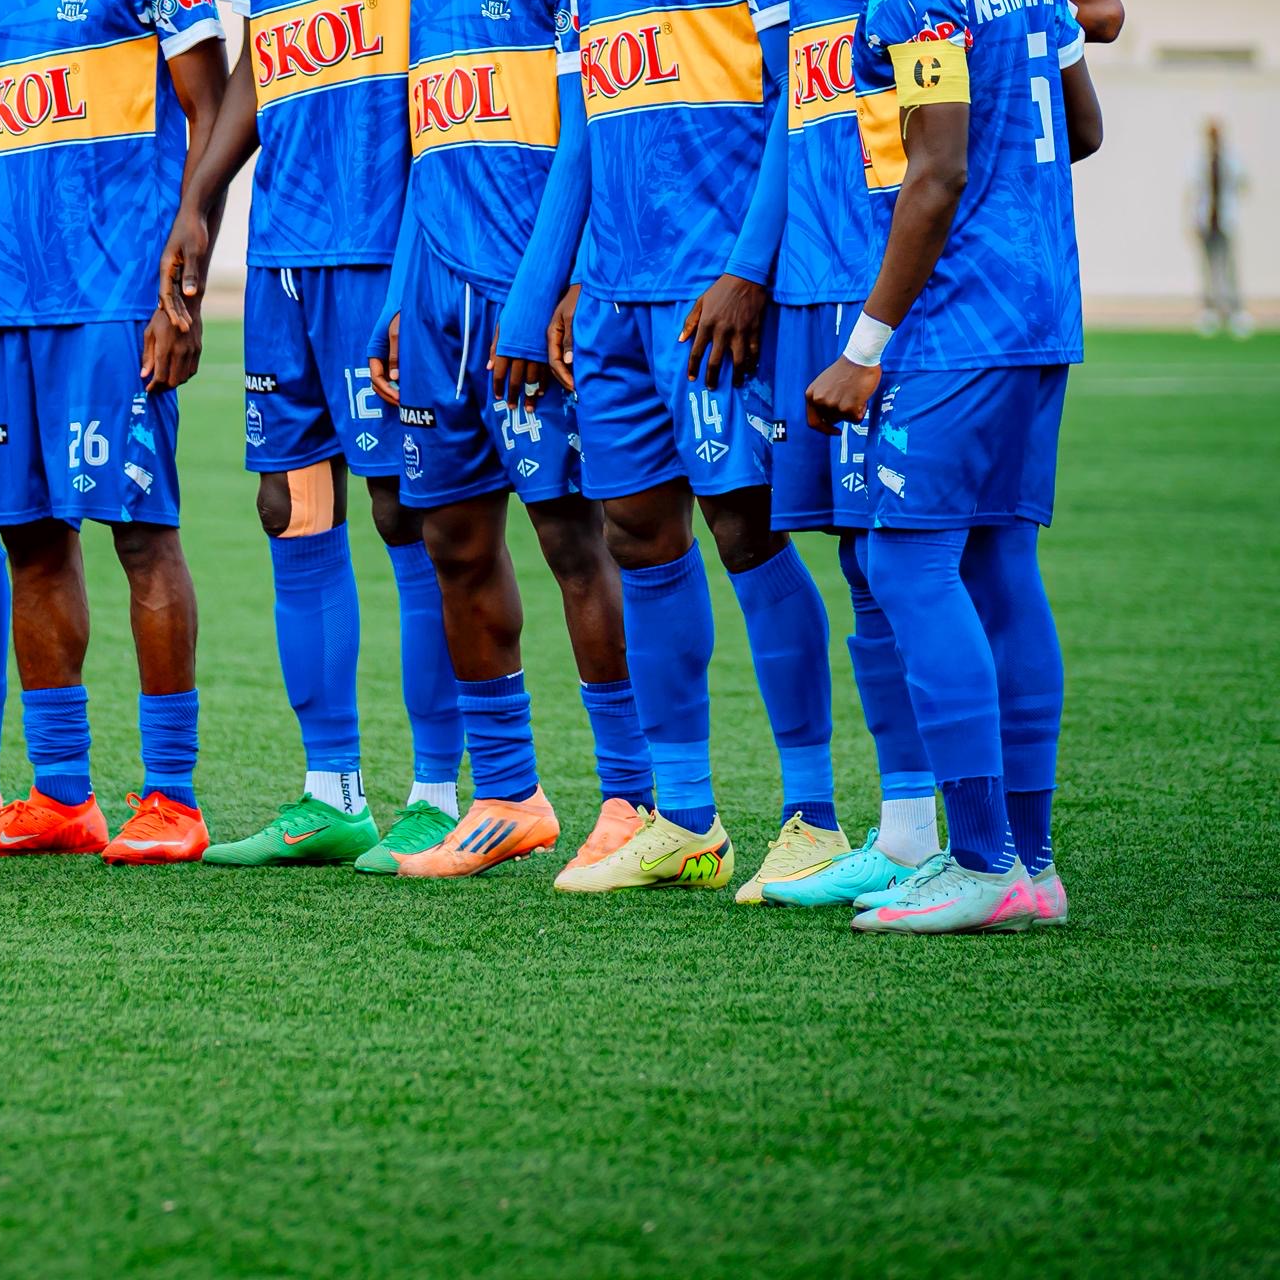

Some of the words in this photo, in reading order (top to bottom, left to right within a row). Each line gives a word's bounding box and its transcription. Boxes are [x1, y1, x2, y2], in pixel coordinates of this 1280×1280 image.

[255, 1, 383, 87] SKOL
[914, 56, 941, 88] C
[344, 367, 383, 419] 12
[688, 389, 722, 439] 14
[69, 420, 109, 469] 26
[492, 396, 542, 450] 24
